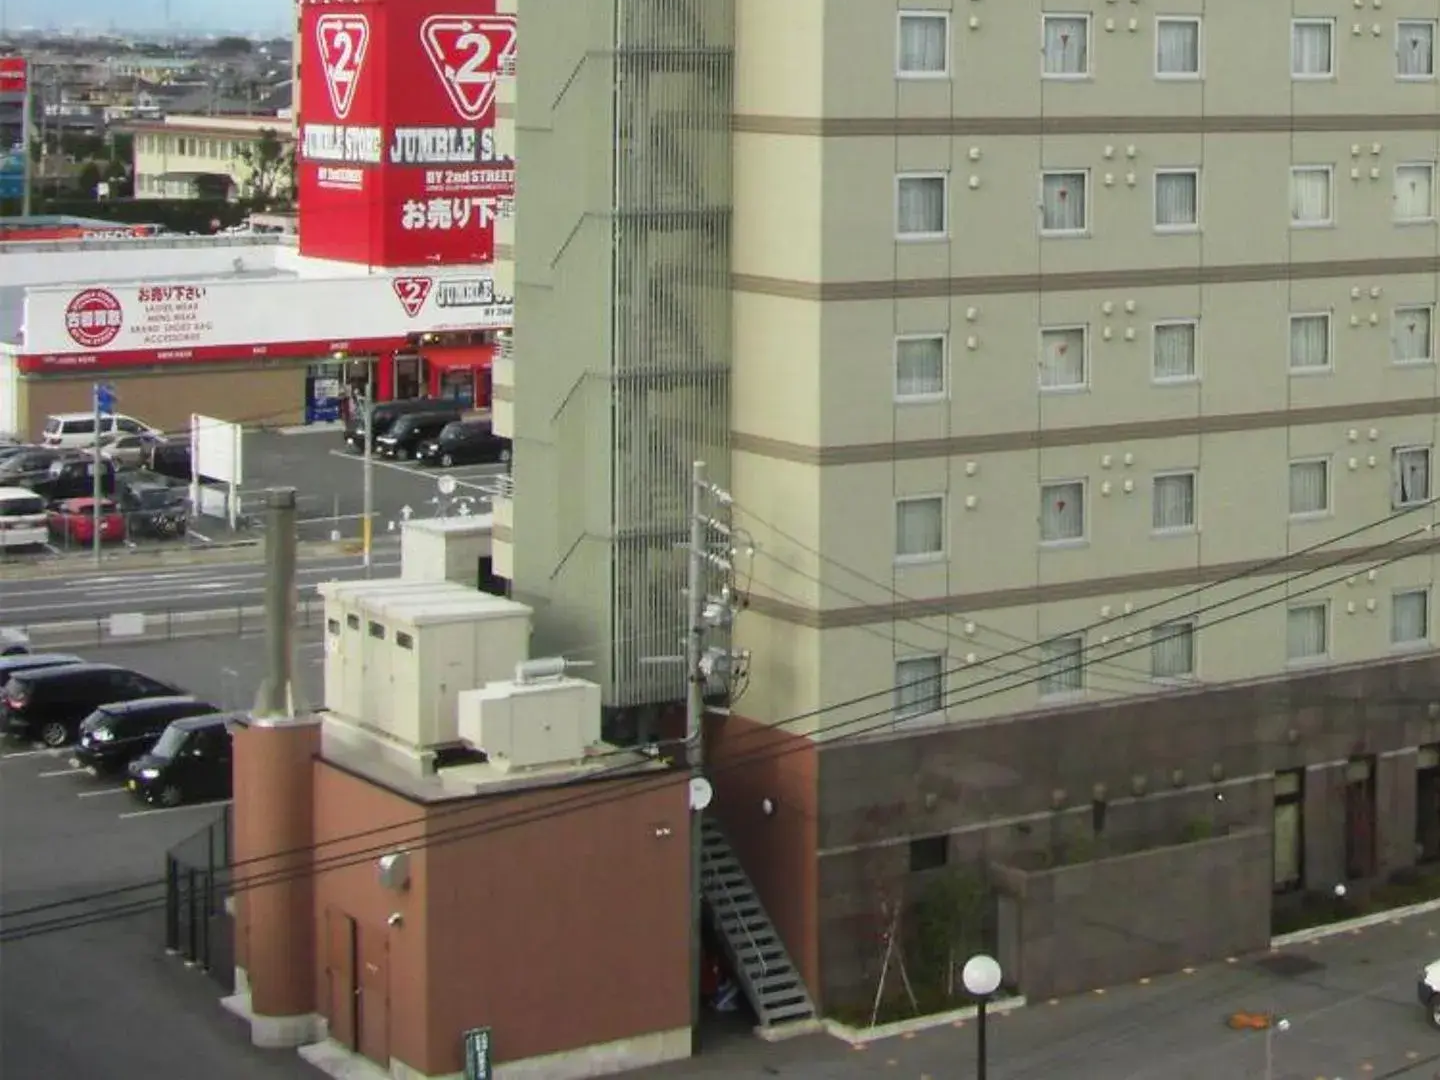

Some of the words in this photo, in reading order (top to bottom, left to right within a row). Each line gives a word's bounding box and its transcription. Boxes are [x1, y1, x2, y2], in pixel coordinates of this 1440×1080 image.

[332, 32, 355, 81] 2
[455, 33, 492, 83] 2
[391, 127, 475, 163] JUMBLE
[405, 283, 421, 304] 2
